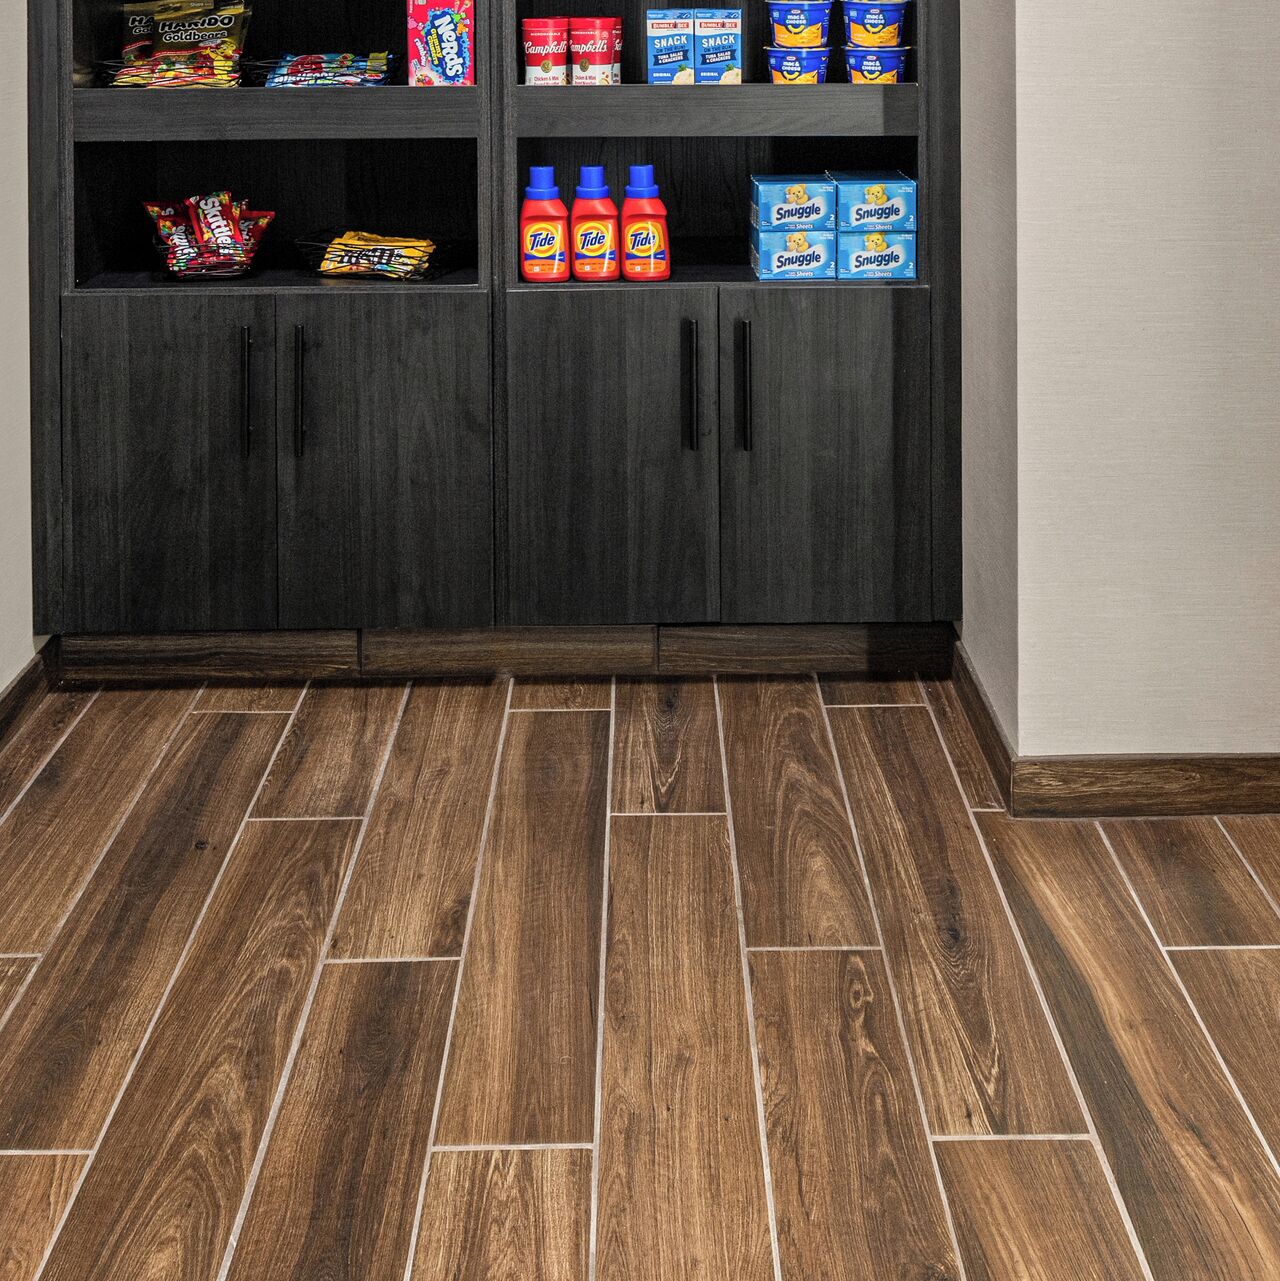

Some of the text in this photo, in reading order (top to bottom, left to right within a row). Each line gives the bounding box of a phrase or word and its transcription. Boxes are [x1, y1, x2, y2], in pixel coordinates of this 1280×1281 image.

[162, 29, 227, 43] Goldbears
[654, 35, 688, 48] SNACK
[702, 35, 735, 47] SNACK
[776, 203, 821, 221] Snuggle
[855, 204, 901, 222] Snuggle
[529, 232, 556, 251] Tide
[580, 231, 606, 251] Tide
[630, 231, 656, 251] Tide
[776, 250, 821, 269] Snuggle
[854, 250, 900, 269] Snuggle
